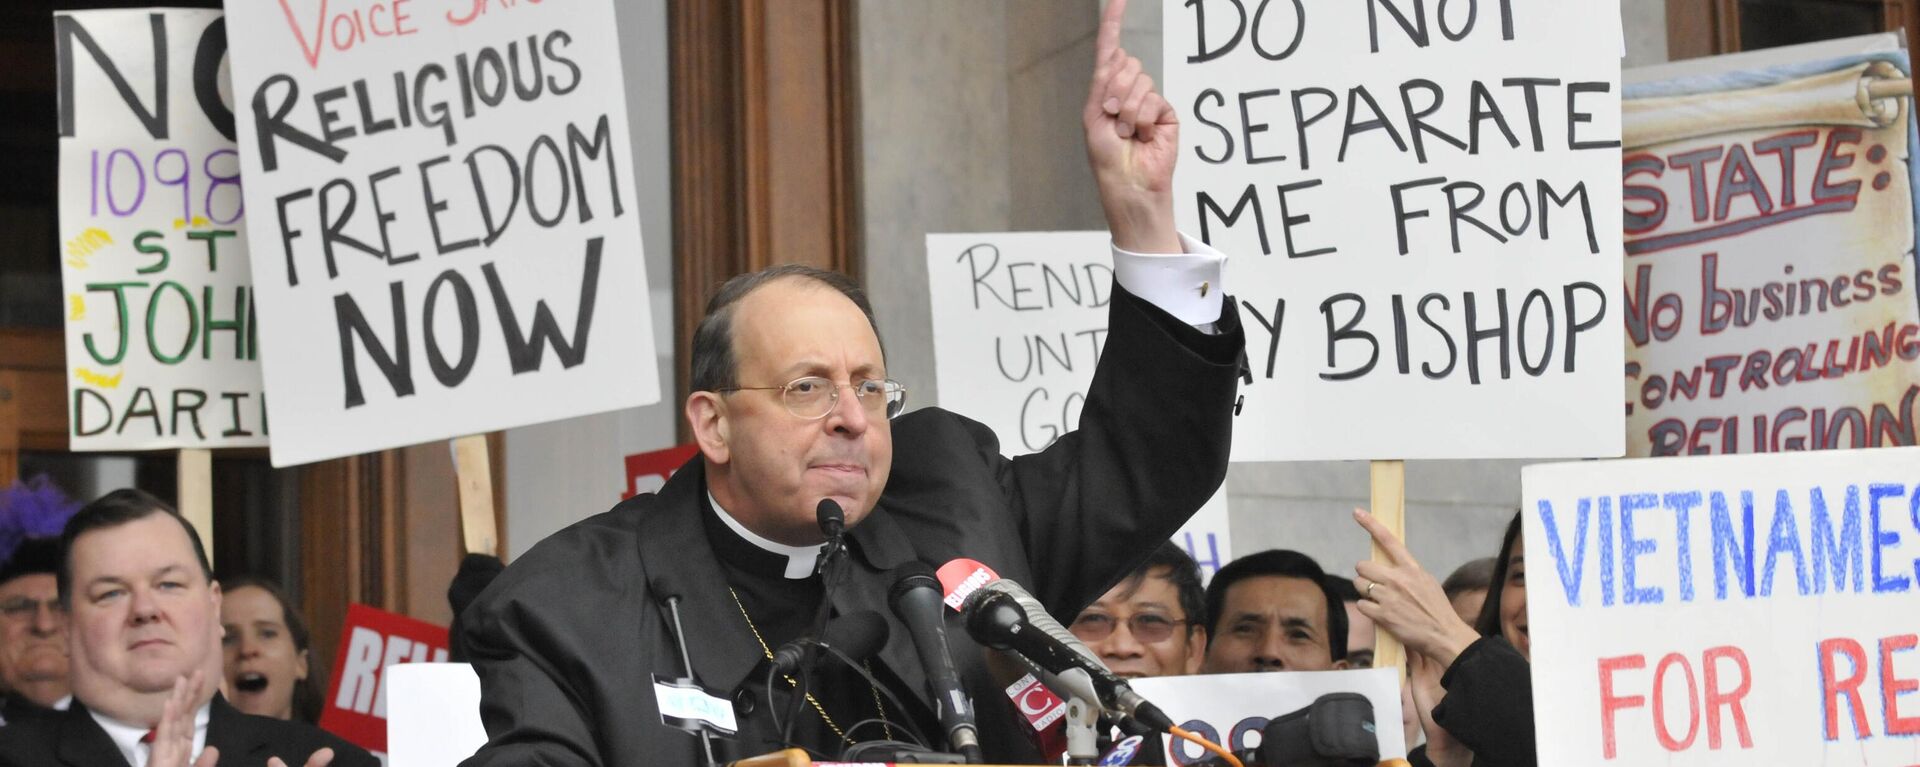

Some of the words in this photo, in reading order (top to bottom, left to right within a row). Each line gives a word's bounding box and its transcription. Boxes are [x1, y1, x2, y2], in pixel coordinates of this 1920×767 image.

[1184, 0, 1305, 63] DO
[252, 30, 581, 172] RELIGIOUS
[1193, 78, 1621, 169] SEPARATE
[91, 149, 244, 224] 1098
[275, 114, 624, 287] FREEDOM
[1197, 179, 1337, 258] ME
[1390, 176, 1600, 255] FROM
[1623, 127, 1892, 236] STATE:
[133, 230, 237, 274] ST
[957, 243, 1115, 311] REND
[1700, 253, 1902, 336] business
[333, 236, 605, 409] NOW
[995, 328, 1109, 382] UNT
[1319, 281, 1606, 384] BISHOP
[1537, 482, 1920, 607] VIETNAME
[1598, 645, 1754, 759] FOR
[1816, 634, 1920, 741] RE
